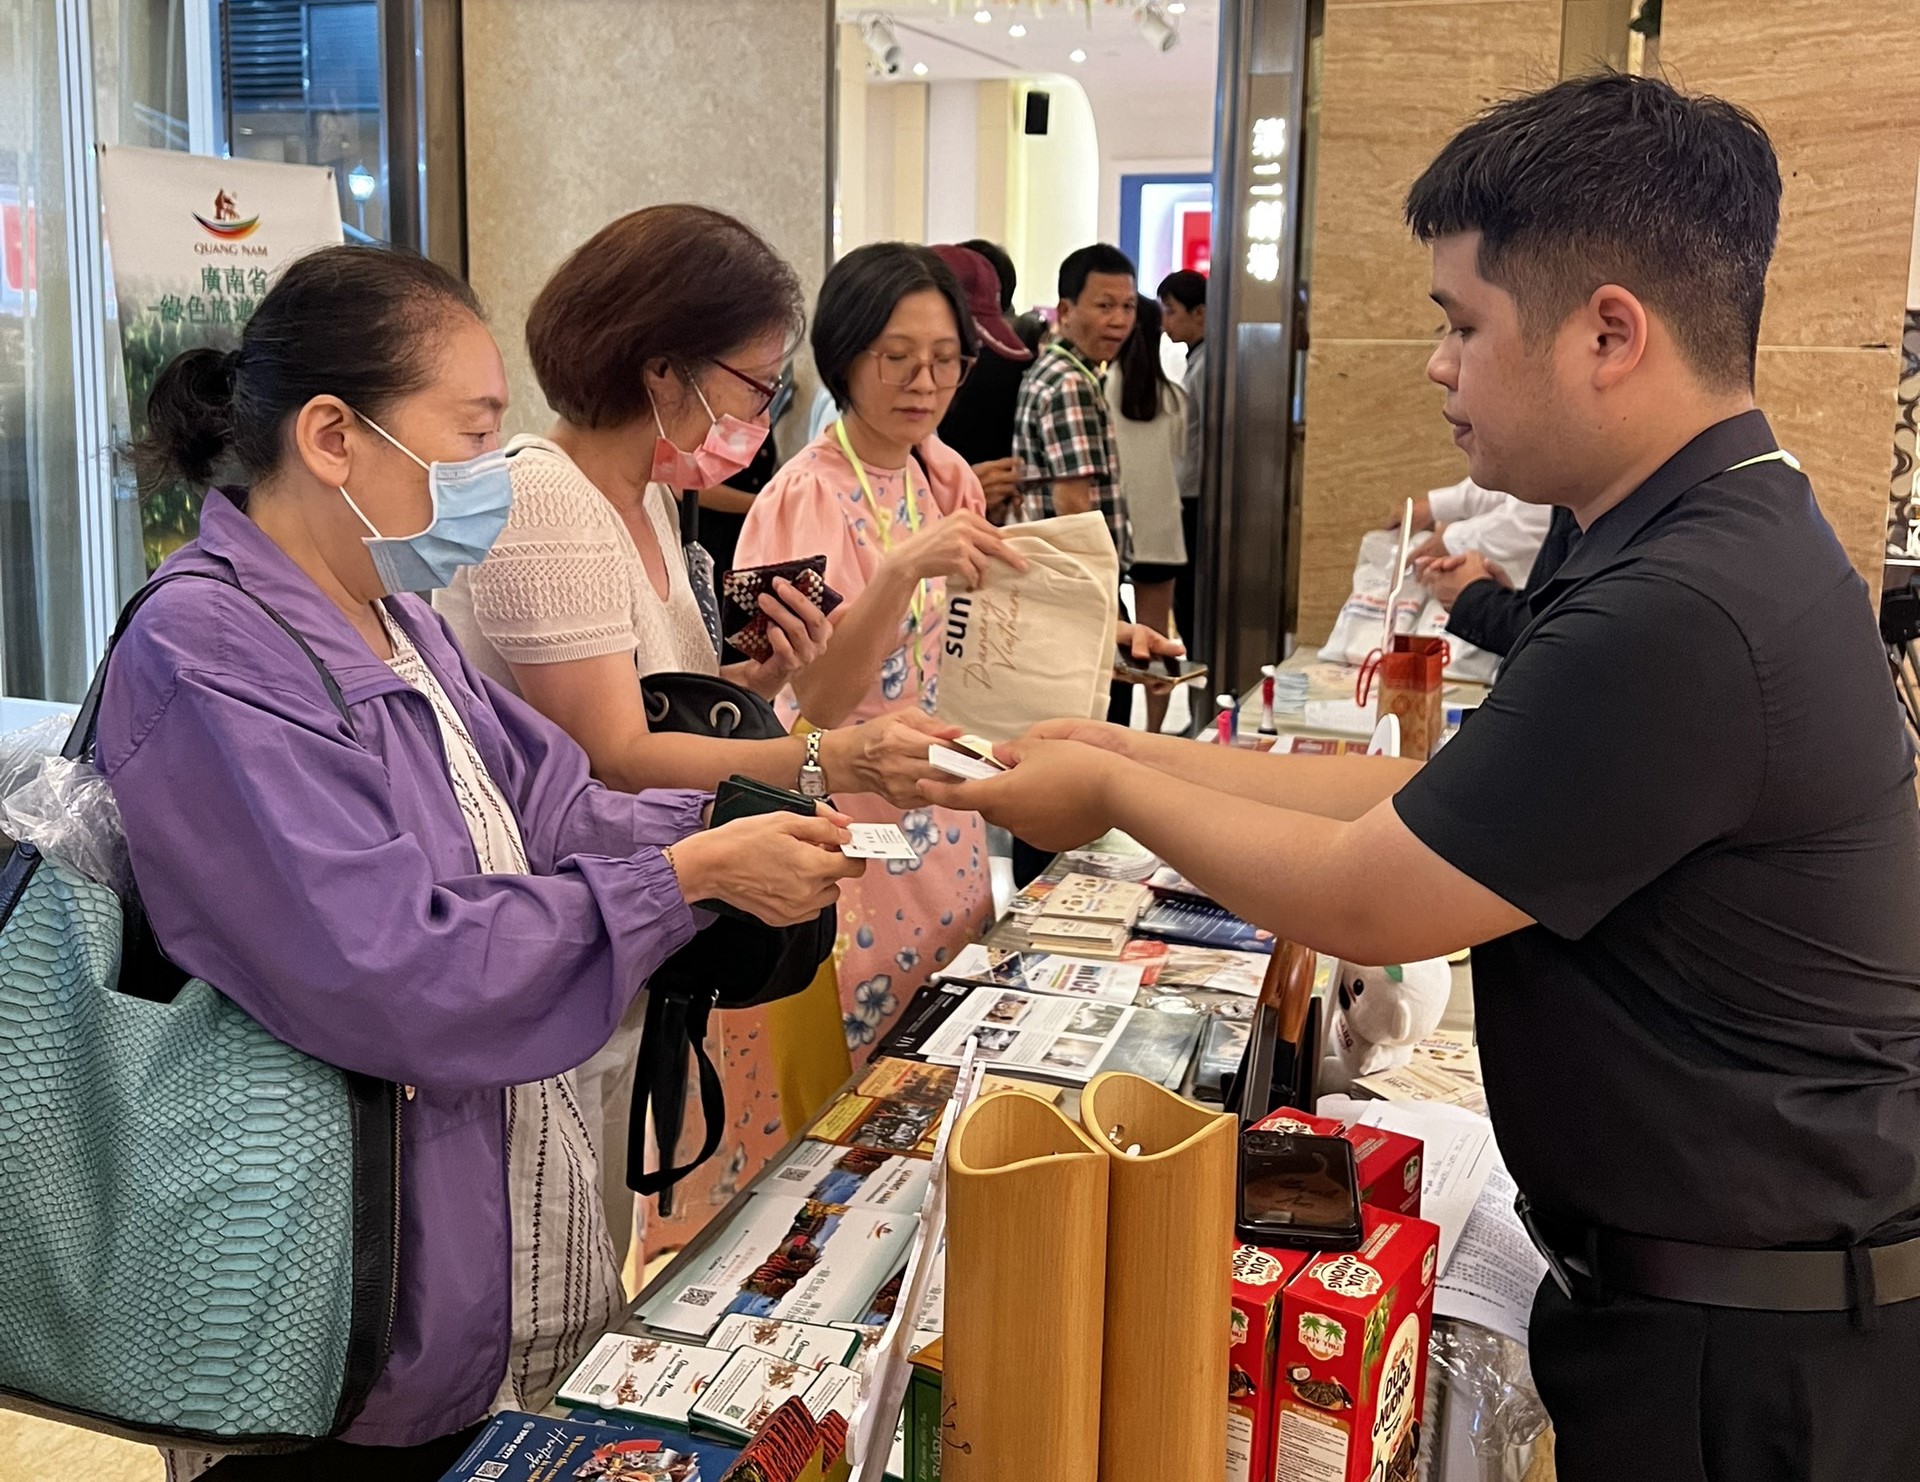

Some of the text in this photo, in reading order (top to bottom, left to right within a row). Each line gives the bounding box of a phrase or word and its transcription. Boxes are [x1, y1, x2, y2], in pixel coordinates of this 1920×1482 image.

[194, 242, 268, 256] QUANG NAM
[202, 263, 268, 295] 廣南省
[945, 596, 972, 658] sun
[962, 597, 1008, 689] Danang
[655, 1358, 690, 1398] Quang Nam
[524, 1426, 569, 1471] Heritage
